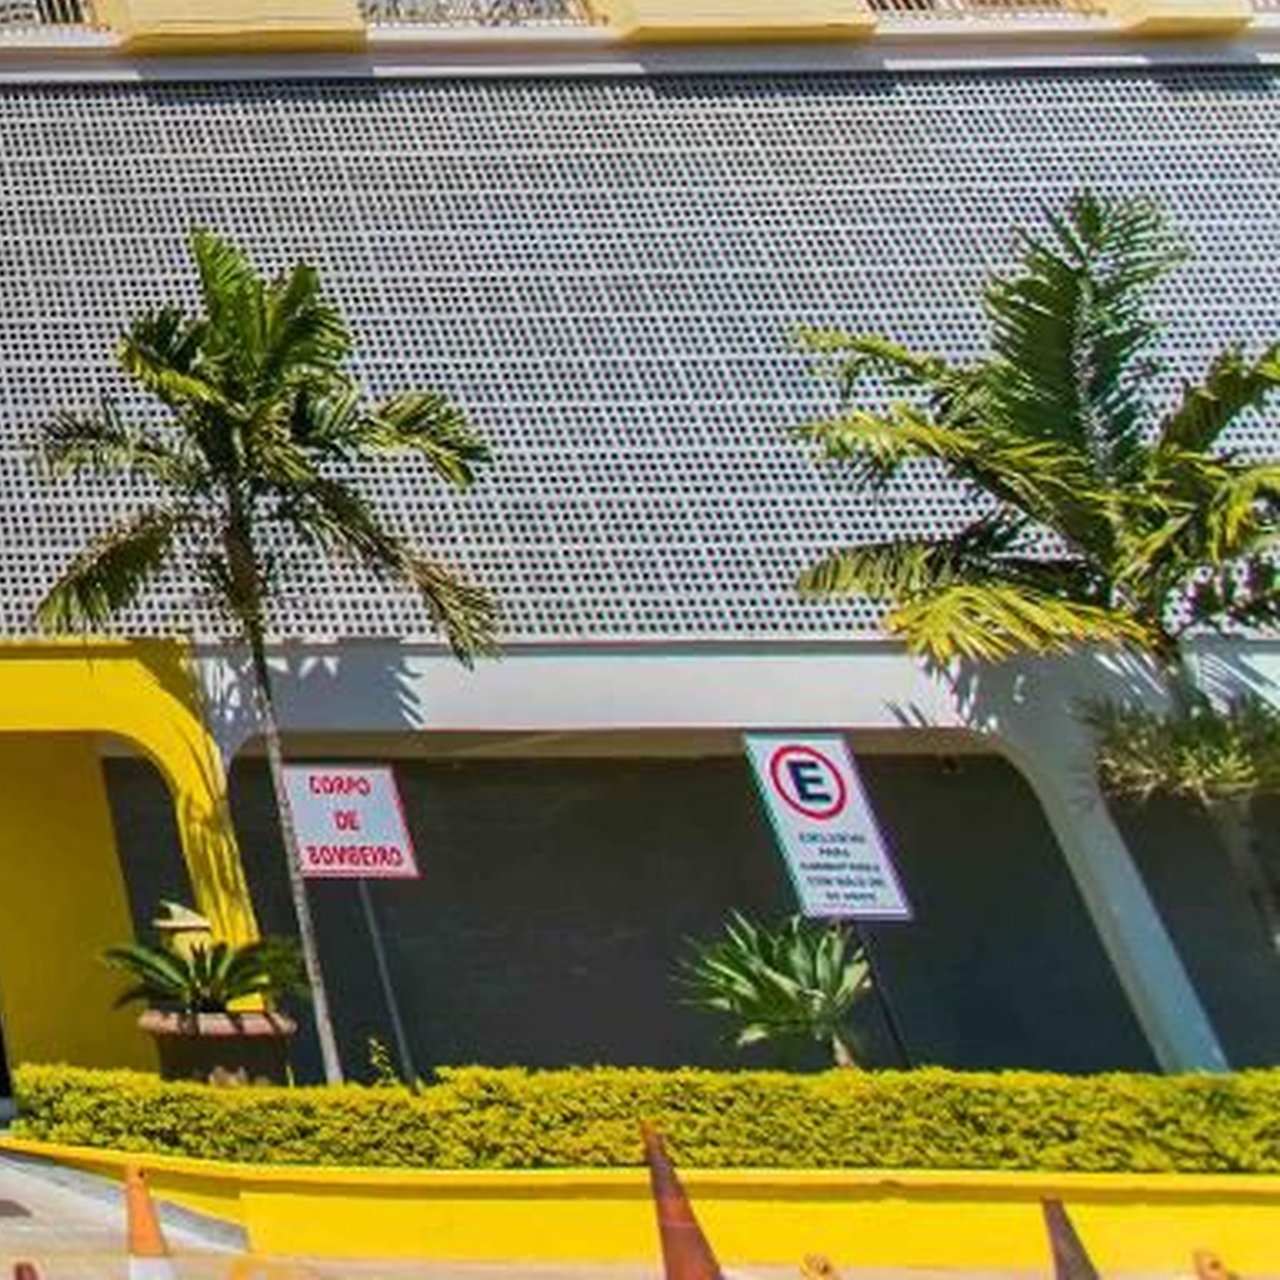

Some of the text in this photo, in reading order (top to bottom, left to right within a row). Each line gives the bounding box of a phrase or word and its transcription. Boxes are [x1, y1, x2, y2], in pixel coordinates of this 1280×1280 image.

[308, 776, 371, 797] CORPO
[786, 761, 832, 803] E
[334, 810, 360, 831] DE
[306, 845, 404, 868] BOMBEIRO
